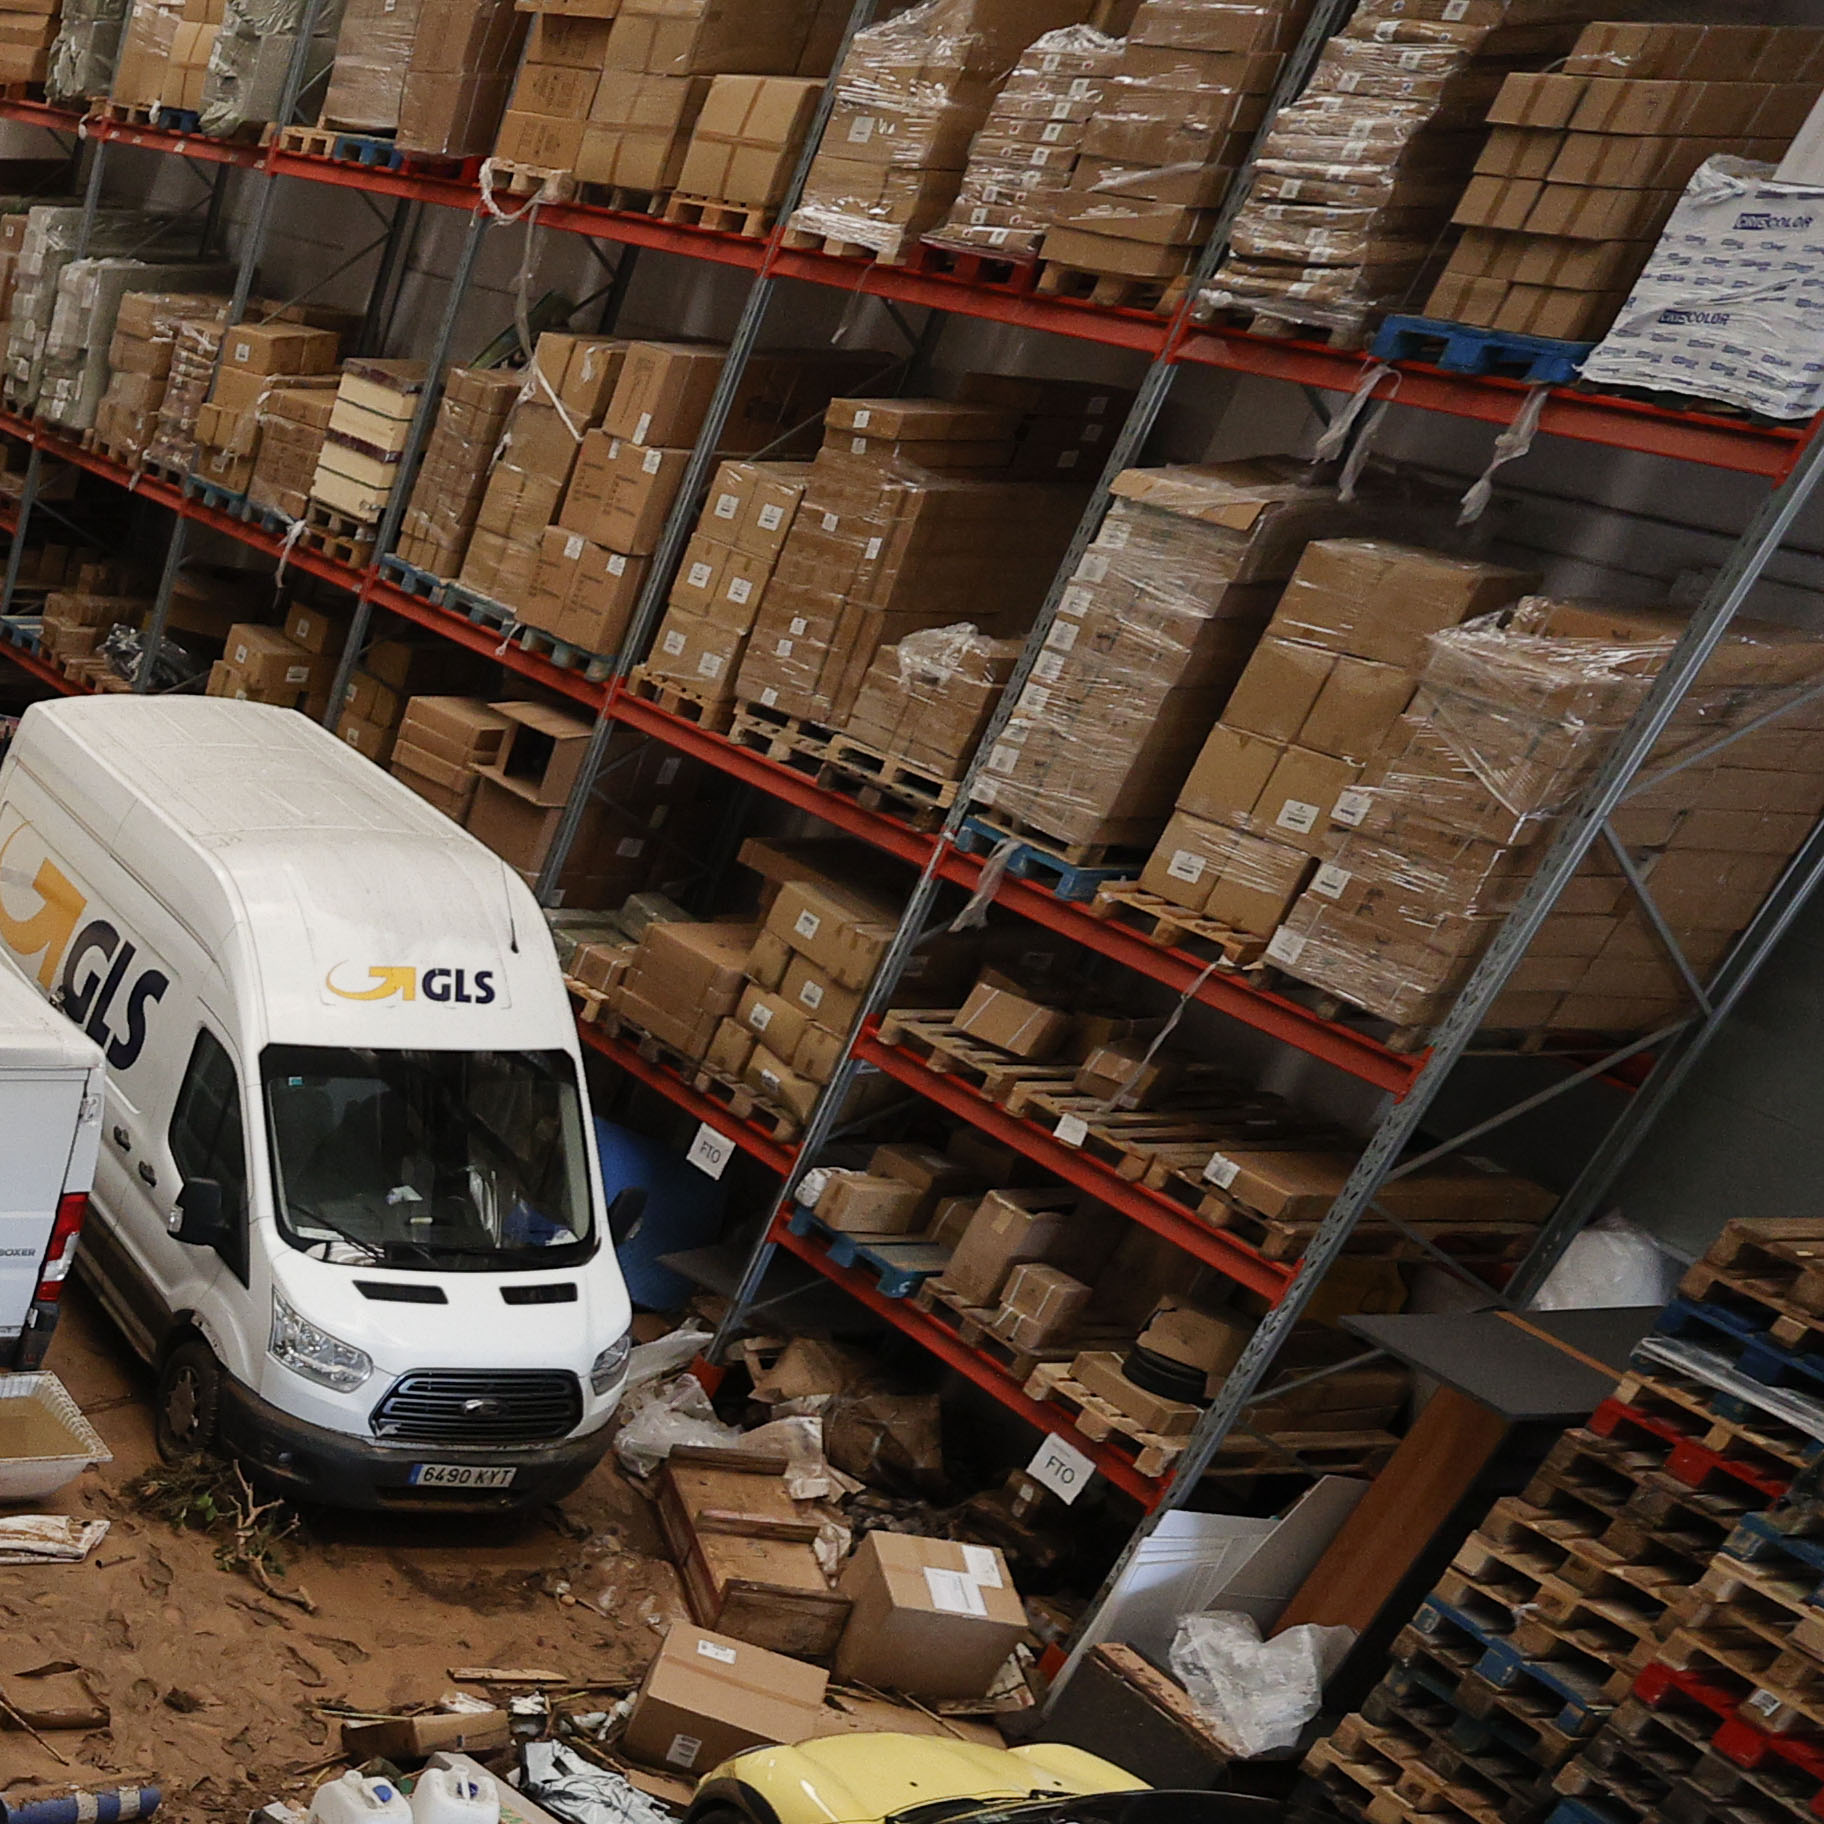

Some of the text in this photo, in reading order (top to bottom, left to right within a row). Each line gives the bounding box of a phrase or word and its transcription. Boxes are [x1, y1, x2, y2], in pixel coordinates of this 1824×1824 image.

[62, 919, 170, 1070] GLS
[422, 968, 495, 1004] GLS
[701, 1141, 722, 1165] FTO
[423, 1466, 513, 1485] 6490 KYT
[1046, 1455, 1076, 1485] FTO
